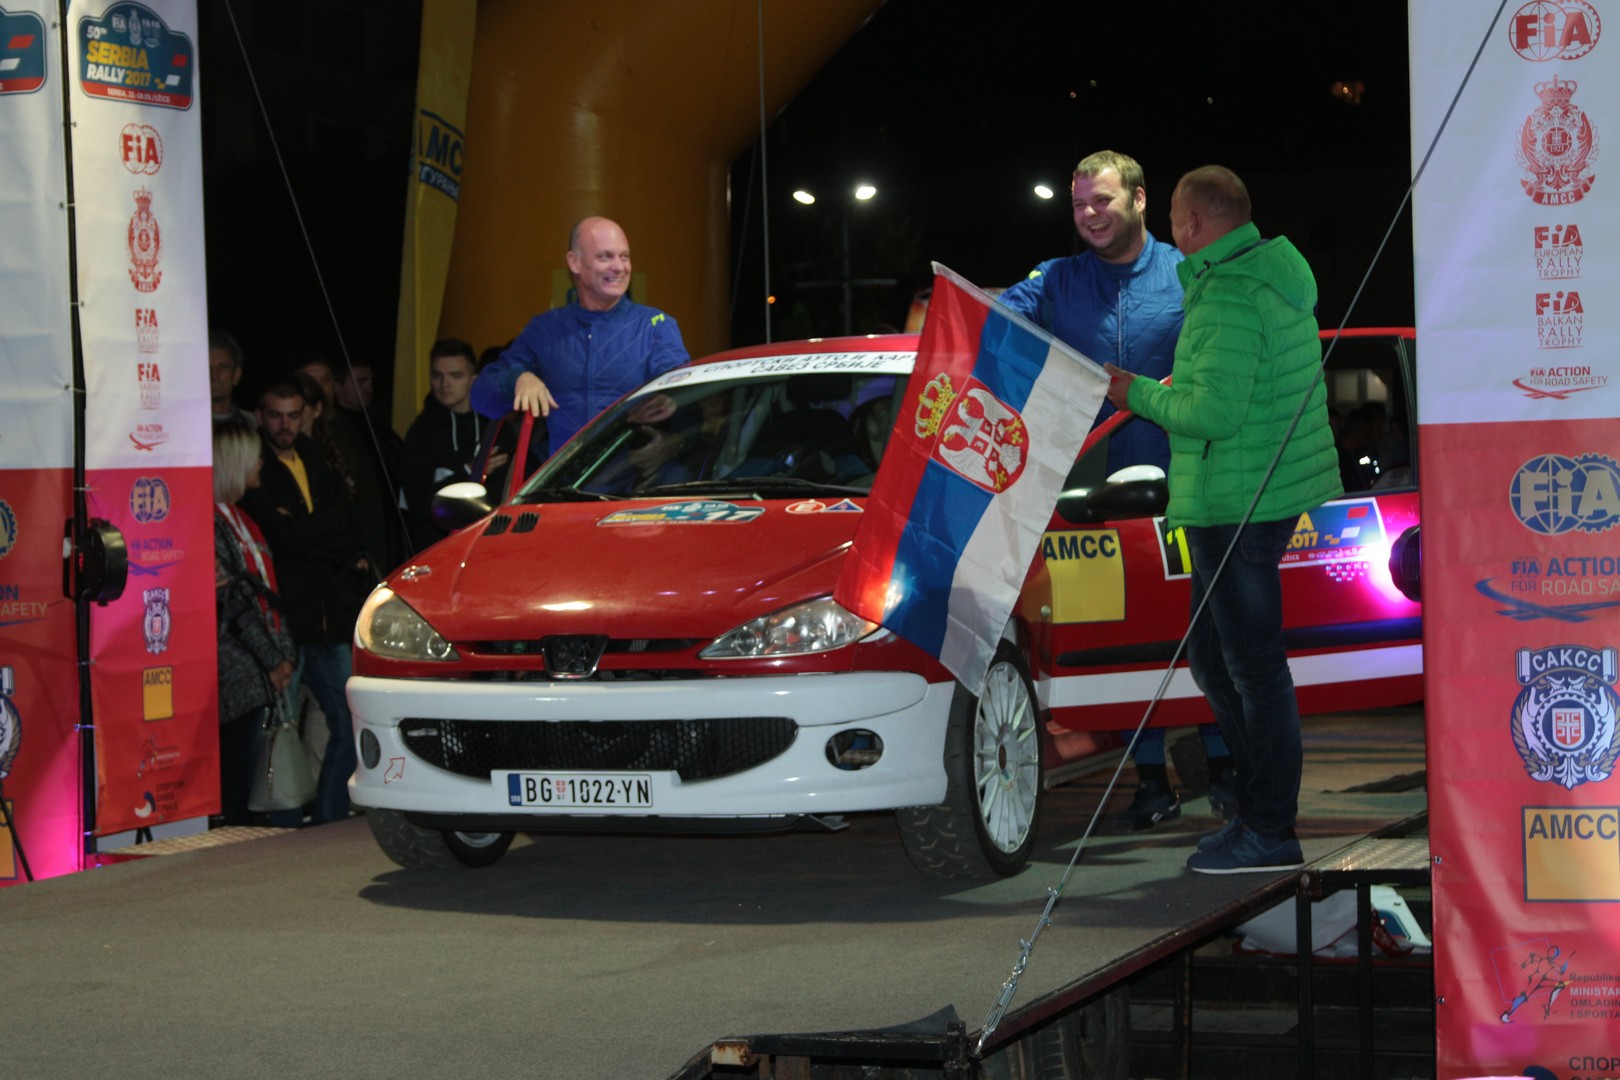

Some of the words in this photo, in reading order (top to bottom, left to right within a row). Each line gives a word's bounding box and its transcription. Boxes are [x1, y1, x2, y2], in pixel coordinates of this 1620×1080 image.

[86, 40, 149, 70] SERBIA
[86, 63, 126, 84] RALLY
[125, 70, 151, 87] 2017
[1534, 247, 1584, 258] EUROPEAN
[1536, 256, 1582, 269] RALLY
[1538, 268, 1581, 278] TROPHY
[1537, 315, 1583, 326] BALKAN
[1537, 325, 1584, 338] RALLY
[1539, 337, 1582, 347] TROPHY
[1548, 366, 1591, 377] ACTION
[1530, 377, 1544, 385] FOR
[1545, 377, 1571, 386] ROAD
[1573, 375, 1608, 386] SAFETY
[704, 510, 761, 521] 17
[1043, 534, 1117, 560] AMCC
[1546, 557, 1620, 577] ACTIO
[1511, 580, 1537, 592] FOR
[1542, 579, 1593, 596] ROAD
[525, 777, 552, 803] BG
